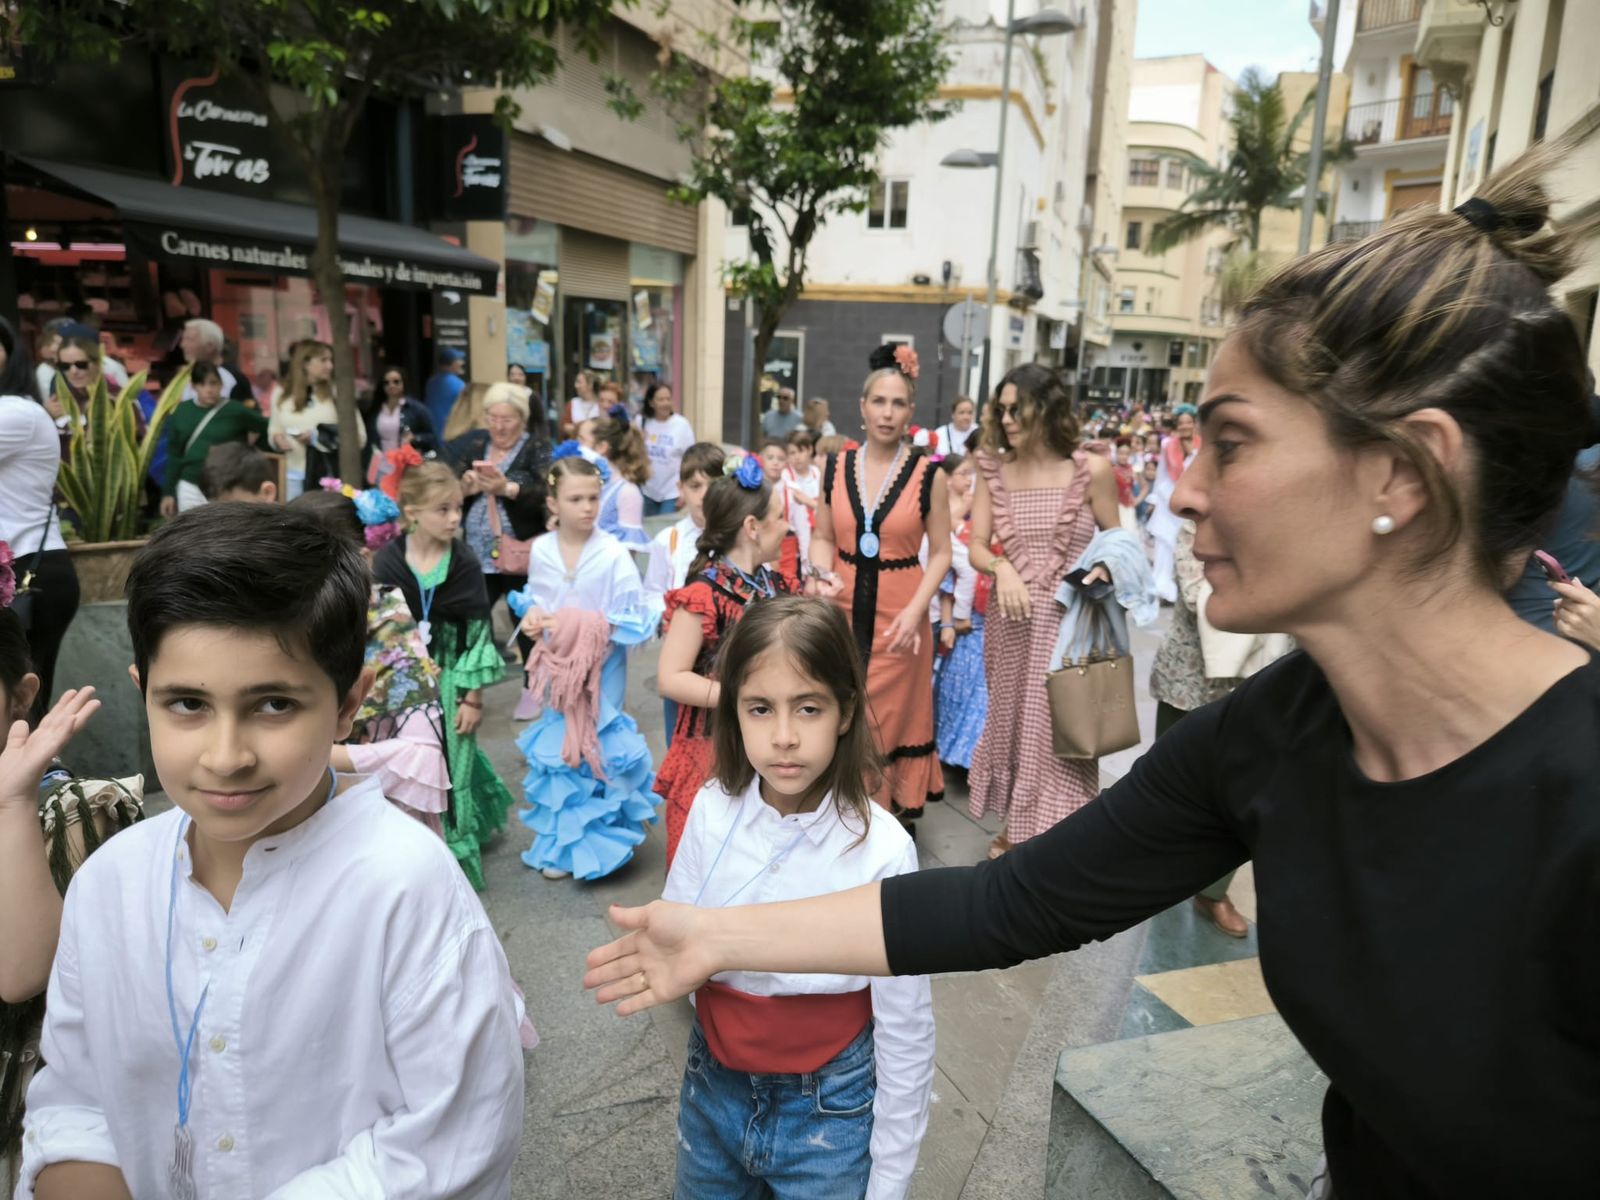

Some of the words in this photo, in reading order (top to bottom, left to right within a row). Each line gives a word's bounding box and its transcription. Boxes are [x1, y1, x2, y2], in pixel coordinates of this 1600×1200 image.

[161, 231, 230, 260] Carnes
[231, 246, 307, 269] naturales
[384, 266, 394, 284] y
[395, 260, 411, 282] de
[412, 264, 483, 290] importación
